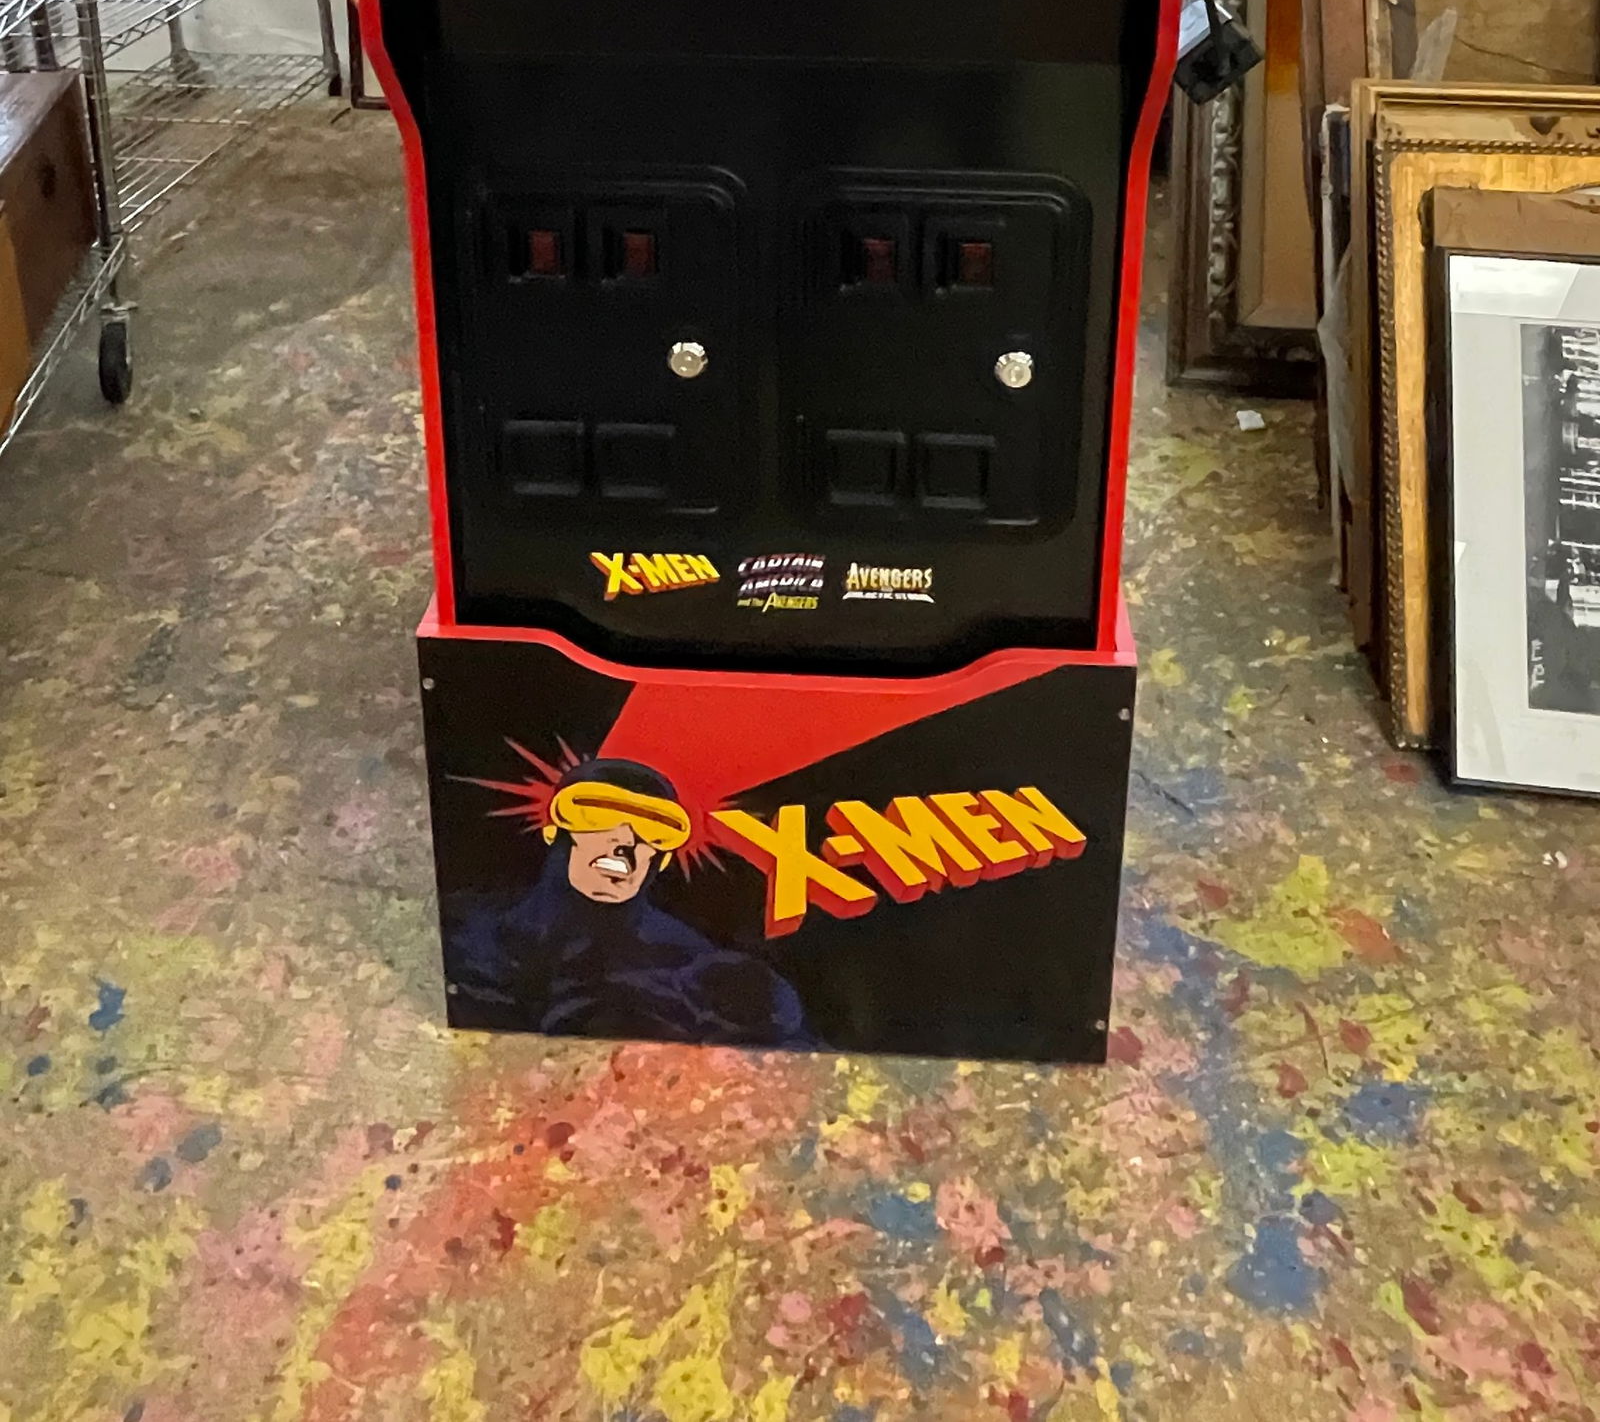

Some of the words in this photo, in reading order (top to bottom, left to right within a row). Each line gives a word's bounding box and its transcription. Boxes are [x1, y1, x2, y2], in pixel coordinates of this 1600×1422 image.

[589, 552, 720, 601] X-MEN
[845, 562, 933, 590] AVENGERS
[706, 786, 1087, 939] X-MEN
